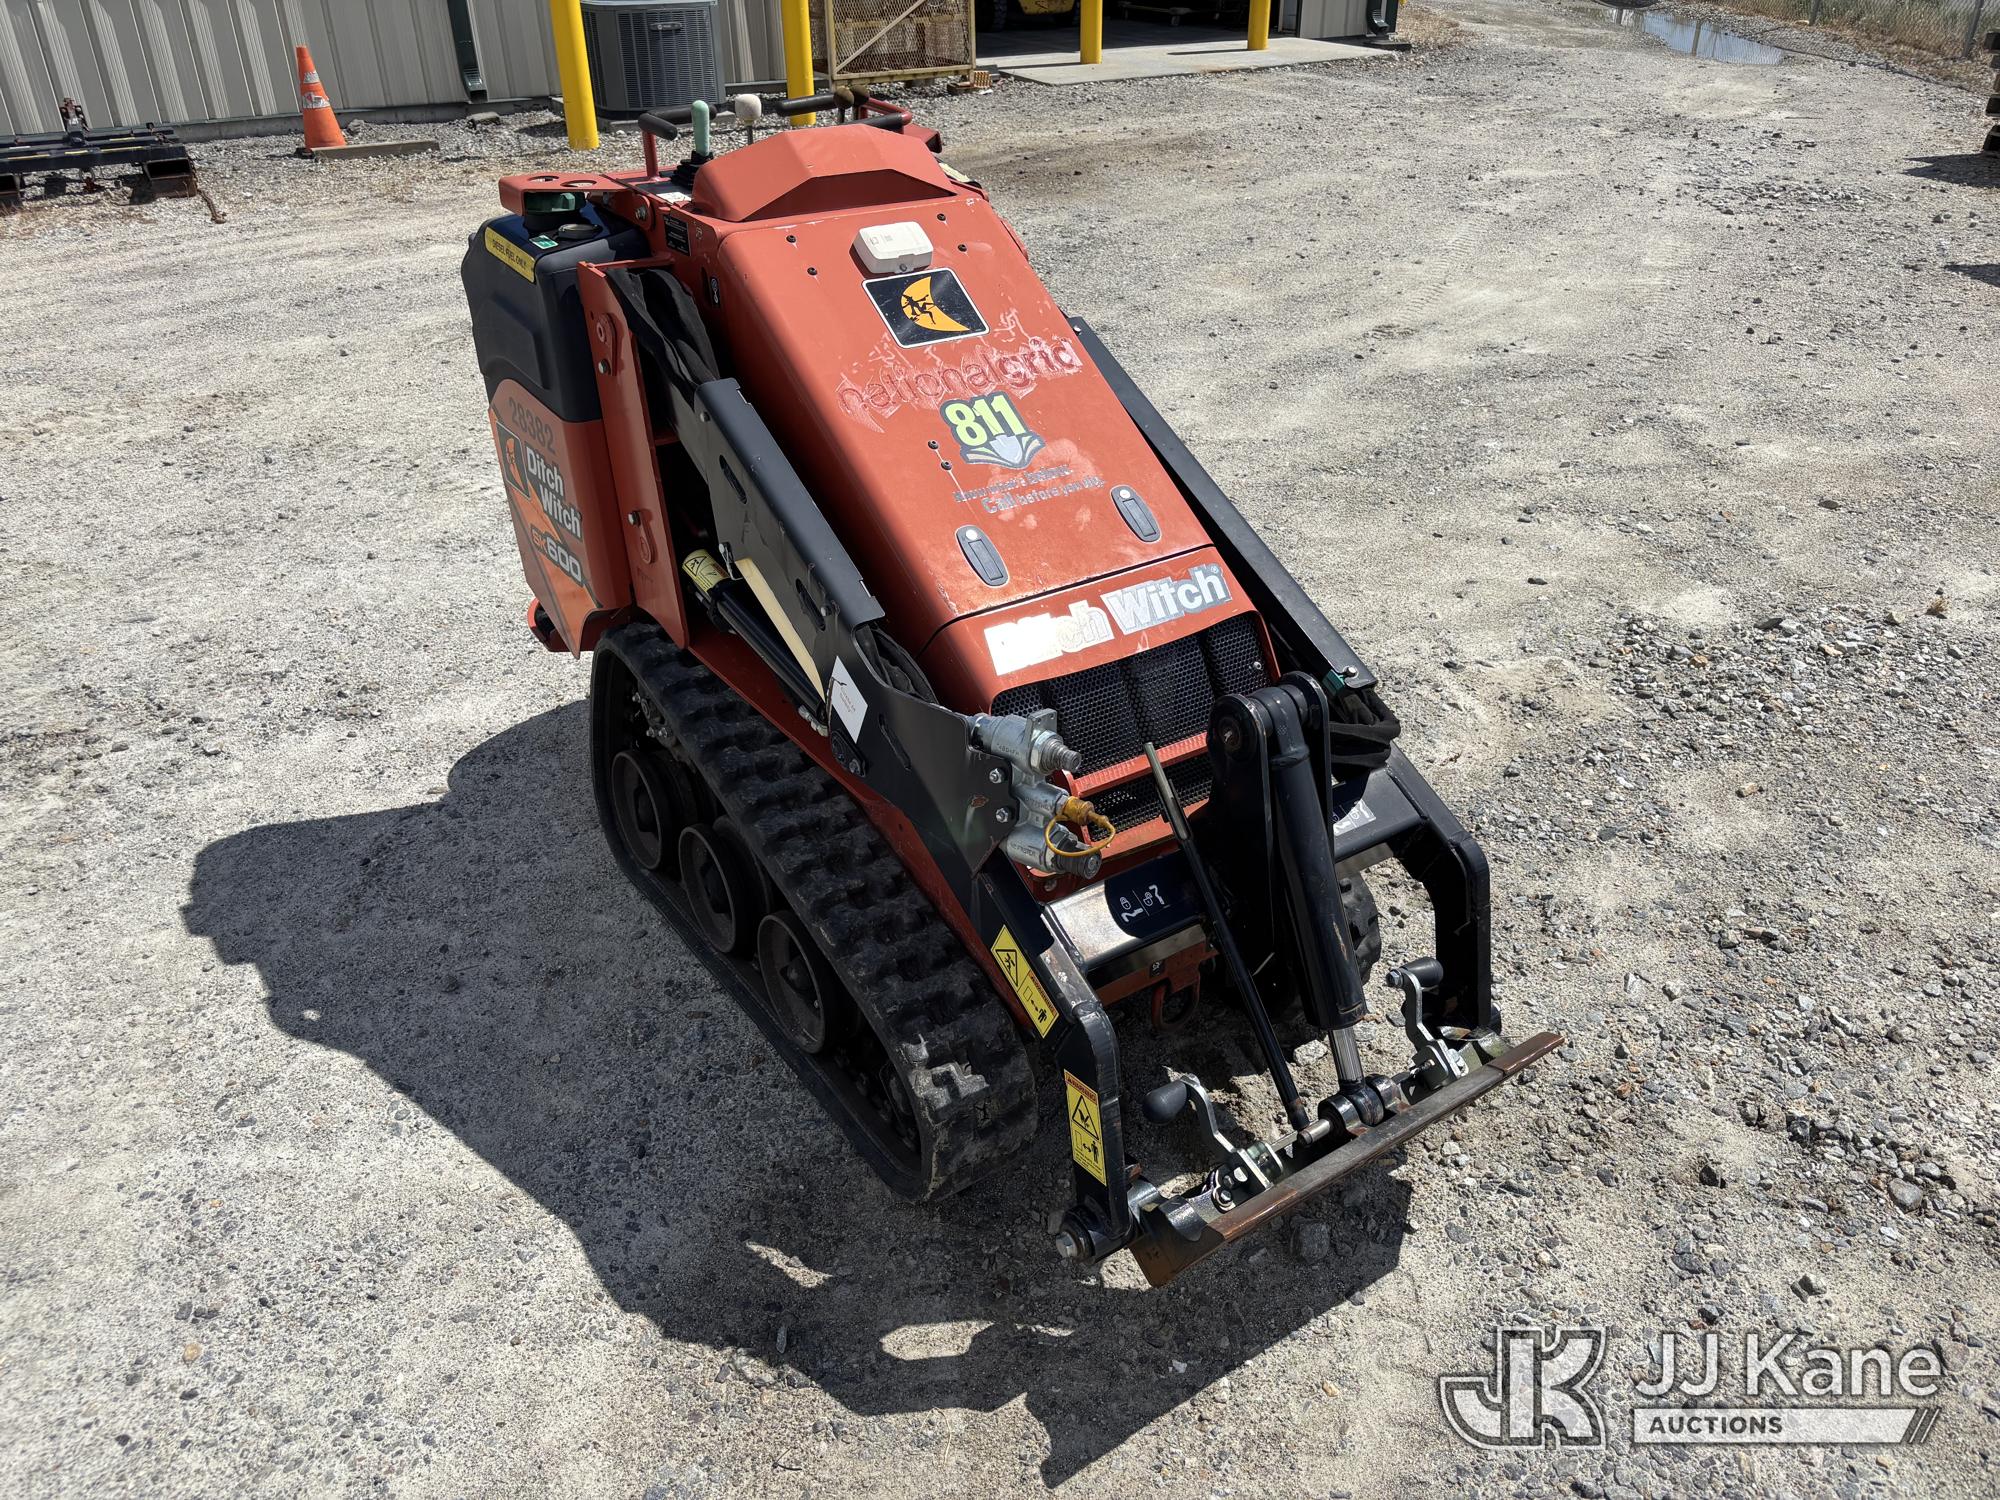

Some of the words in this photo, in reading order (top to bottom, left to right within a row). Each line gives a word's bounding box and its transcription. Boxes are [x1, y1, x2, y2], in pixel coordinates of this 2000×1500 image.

[509, 396, 556, 454] 28382
[944, 394, 1026, 446] 811
[526, 446, 565, 497] Ditch
[540, 484, 582, 538] Witch
[980, 491, 1017, 513] Call
[1016, 486, 1060, 506] before
[531, 529, 582, 582] SK600
